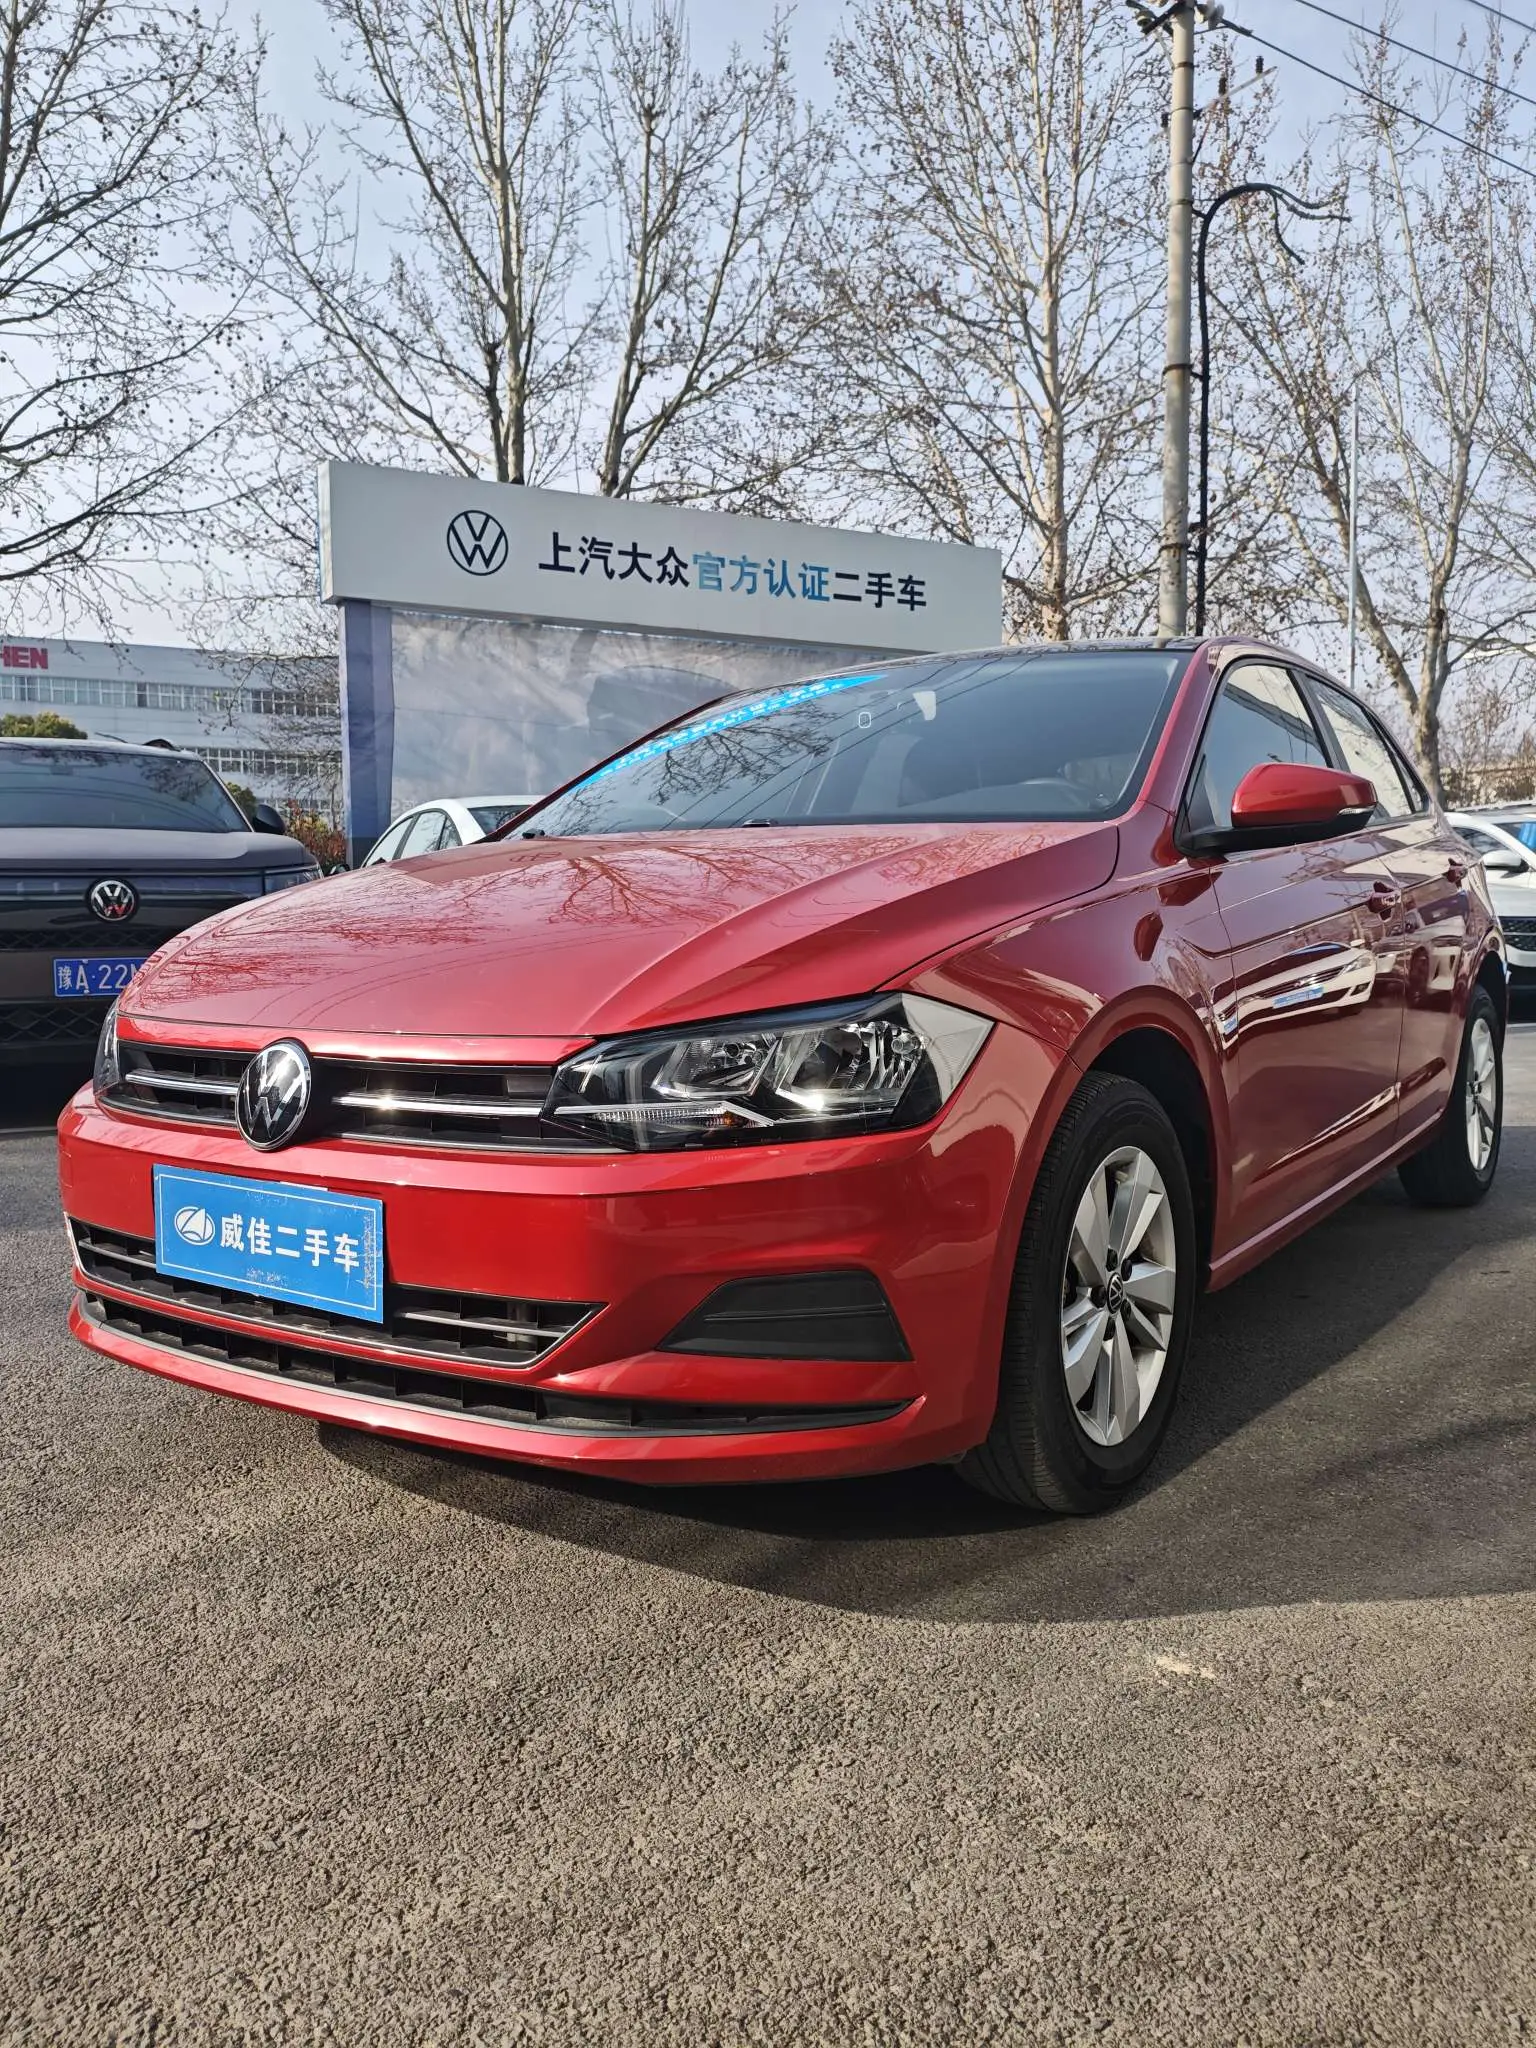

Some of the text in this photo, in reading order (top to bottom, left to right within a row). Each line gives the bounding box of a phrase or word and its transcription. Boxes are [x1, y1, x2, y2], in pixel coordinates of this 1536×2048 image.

[538, 531, 927, 611] 上汽大众官方认证二手车
[220, 1213, 360, 1274] 威佳二手车
